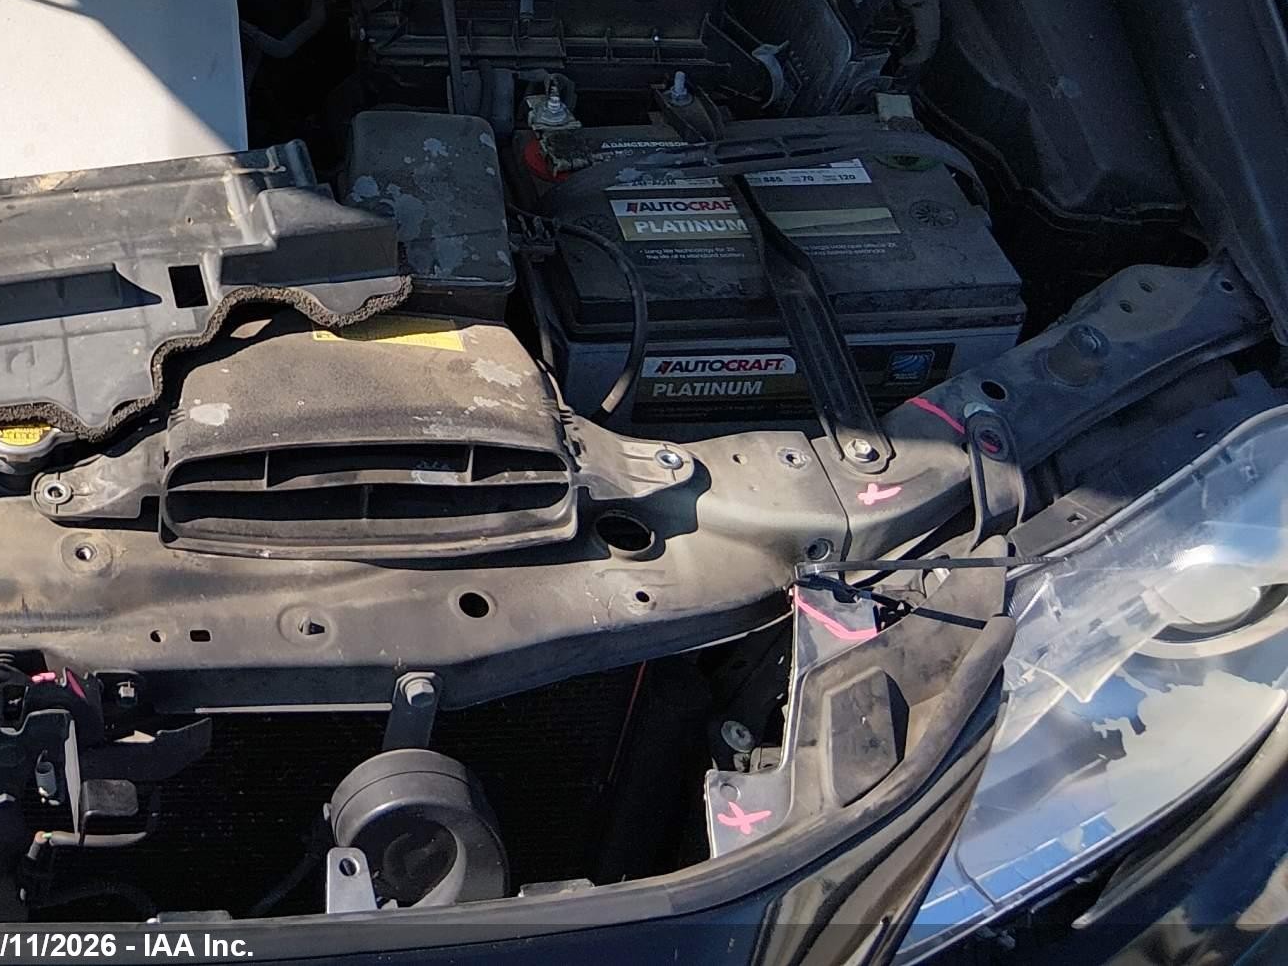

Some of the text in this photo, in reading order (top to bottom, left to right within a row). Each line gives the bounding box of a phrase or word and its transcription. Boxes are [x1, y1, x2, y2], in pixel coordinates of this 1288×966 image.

[639, 201, 736, 212] AUTOCRAF
[634, 219, 748, 234] PLATINUM
[671, 358, 784, 373] AUTOCRAFT
[653, 380, 762, 397] PLATINUM
